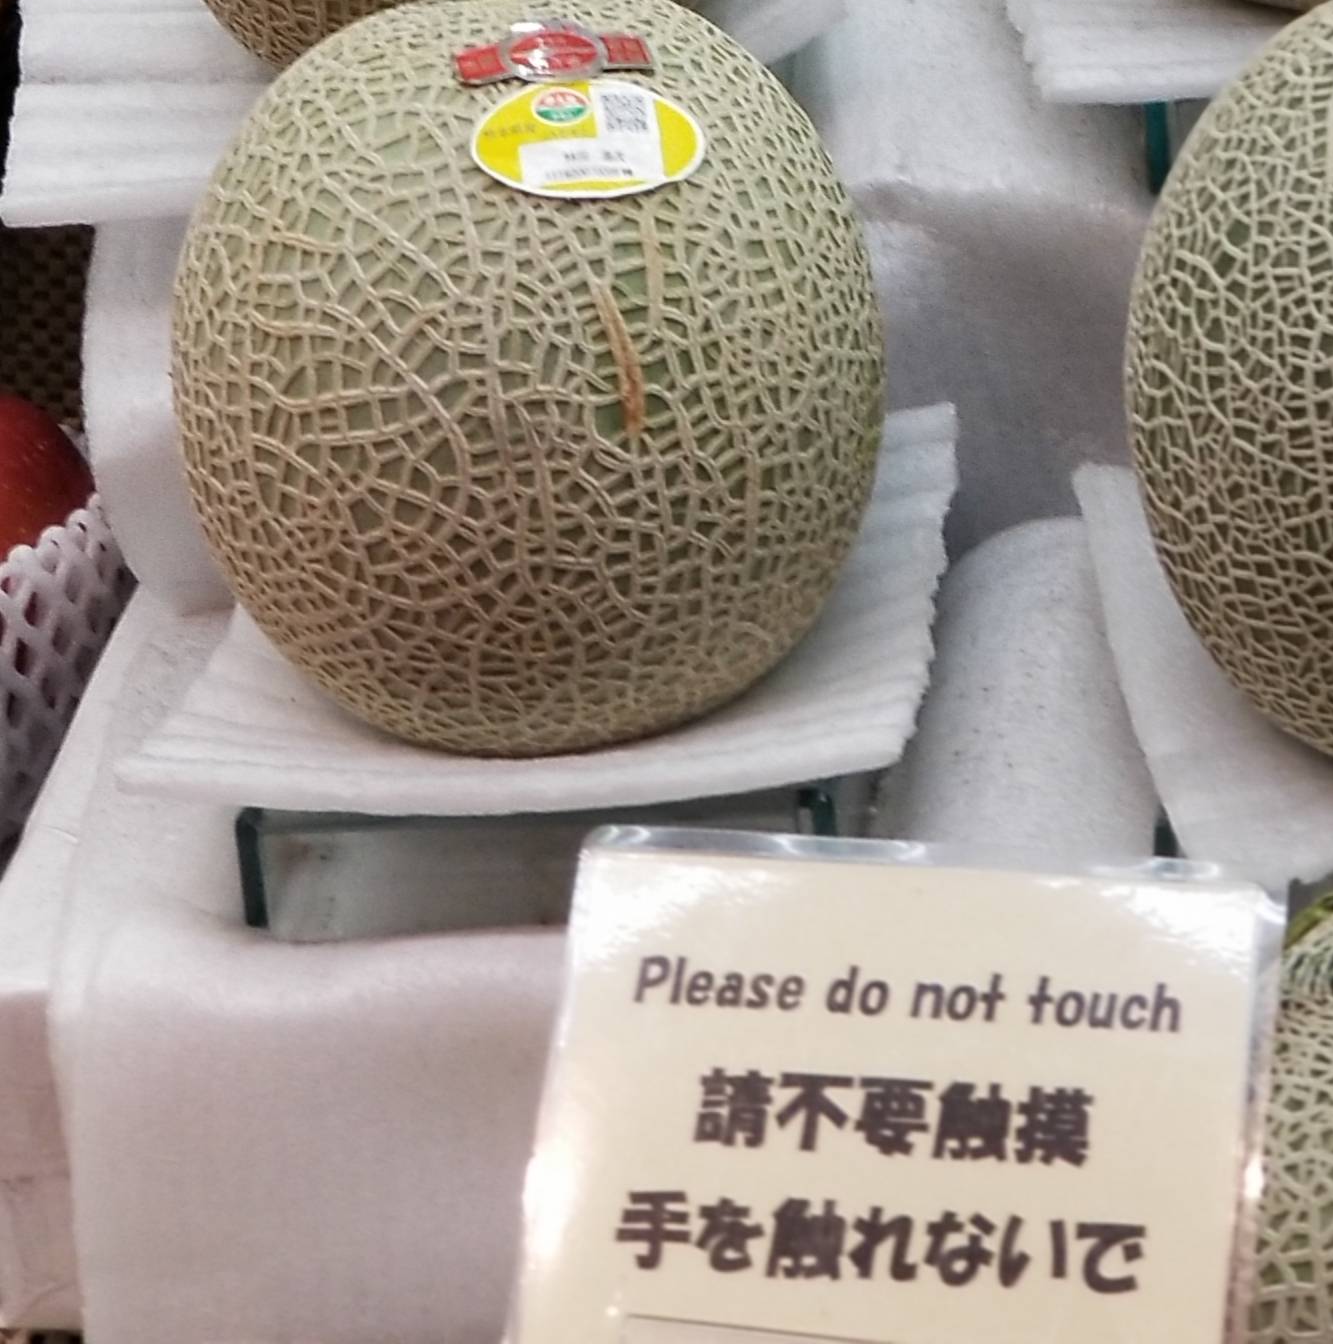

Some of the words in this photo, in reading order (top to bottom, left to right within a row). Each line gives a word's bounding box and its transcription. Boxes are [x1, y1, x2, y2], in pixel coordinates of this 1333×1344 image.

[632, 954, 802, 1011] Please
[825, 963, 890, 1017] do
[909, 973, 1007, 1024] not
[1027, 975, 1183, 1034] touch
[692, 1066, 1096, 1169] 請不要触摸
[614, 1187, 1149, 1296] 手を触れないで
